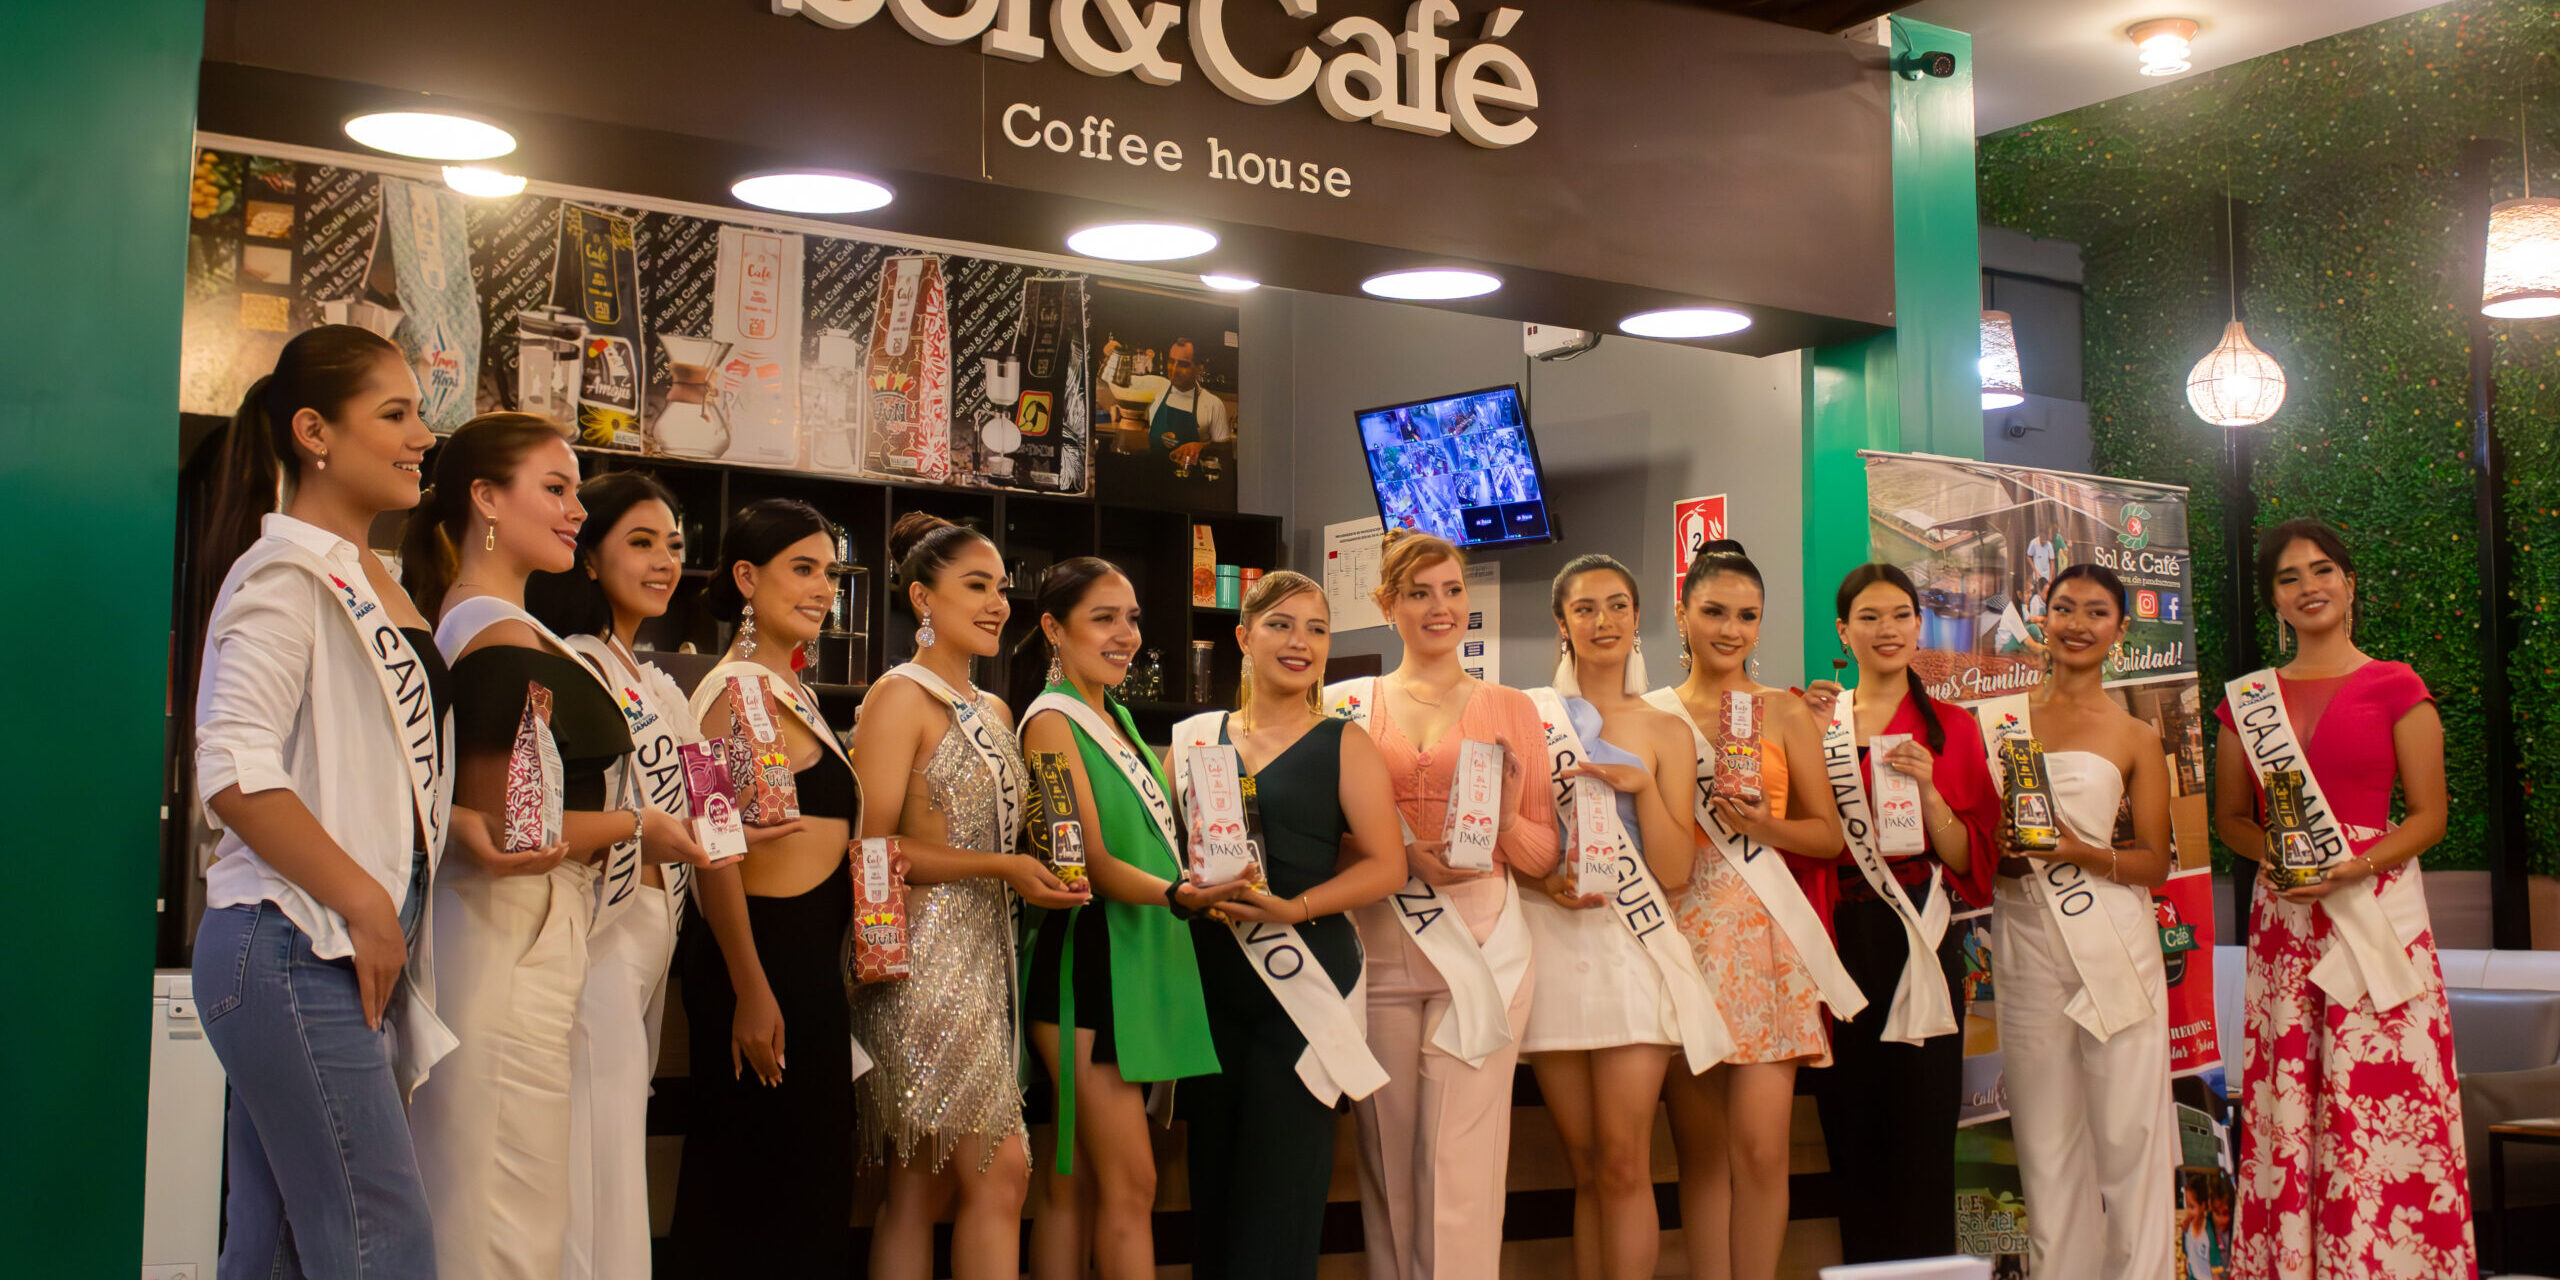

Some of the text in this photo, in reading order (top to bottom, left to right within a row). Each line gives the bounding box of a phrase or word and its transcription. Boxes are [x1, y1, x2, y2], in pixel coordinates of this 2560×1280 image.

[1002, 103, 1353, 199] Coffee house
[1693, 532, 1702, 552] 2
[2095, 546, 2180, 576] Sol & Café
[2112, 640, 2183, 673] Calidad!
[1926, 661, 2042, 700] mos Familia
[1552, 749, 1577, 808] SA
[1459, 831, 1491, 847] PAKAS
[1884, 815, 1917, 830] PAKAS
[1209, 842, 1244, 858] PAKAS
[608, 841, 637, 908] IN
[1617, 836, 1665, 949] GUEL
[2044, 860, 2093, 917] CIO
[1395, 876, 1443, 935] ZA
[1236, 921, 1304, 981] VO
[1987, 1210, 2014, 1231] del
